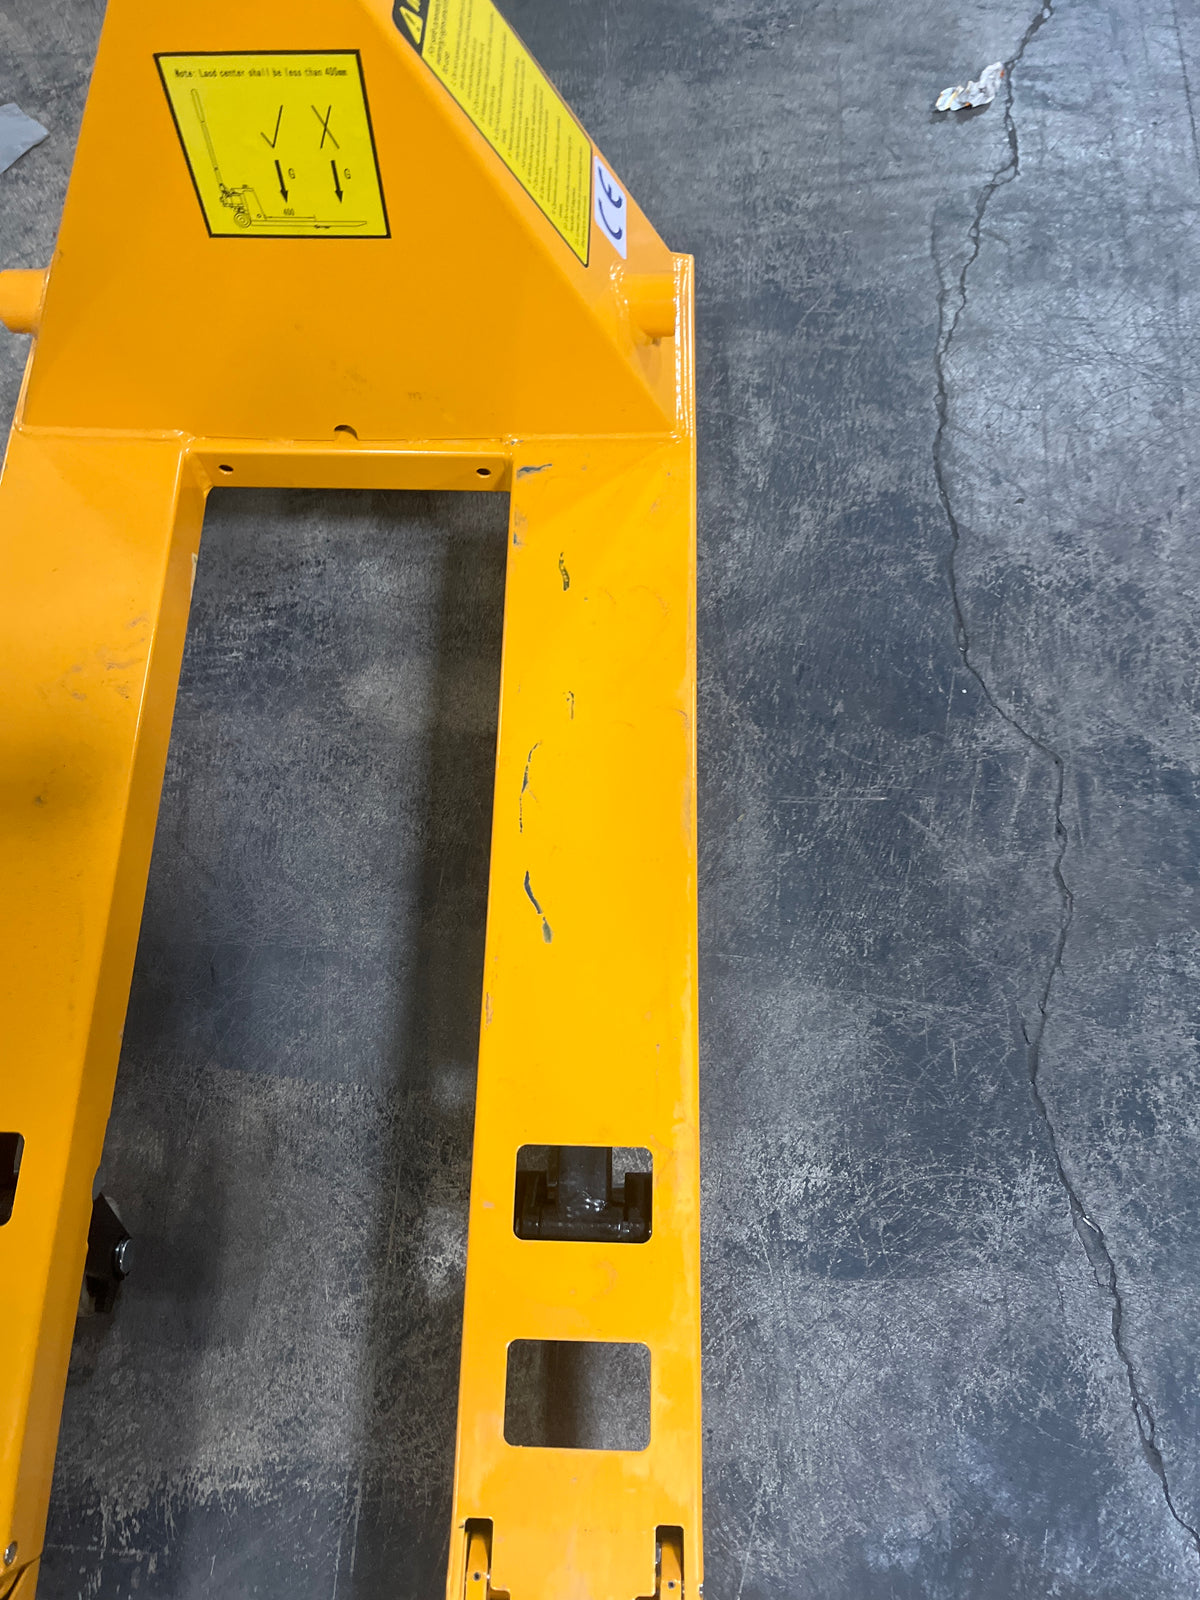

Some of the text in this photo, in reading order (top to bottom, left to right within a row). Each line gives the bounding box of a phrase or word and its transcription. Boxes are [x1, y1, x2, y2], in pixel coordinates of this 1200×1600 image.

[174, 69, 194, 77] Note:
[219, 69, 245, 77] center
[248, 67, 269, 77] shall
[272, 67, 282, 77] be
[285, 66, 302, 77] less
[304, 66, 323, 76] than
[288, 167, 296, 179] G
[343, 167, 352, 179] G
